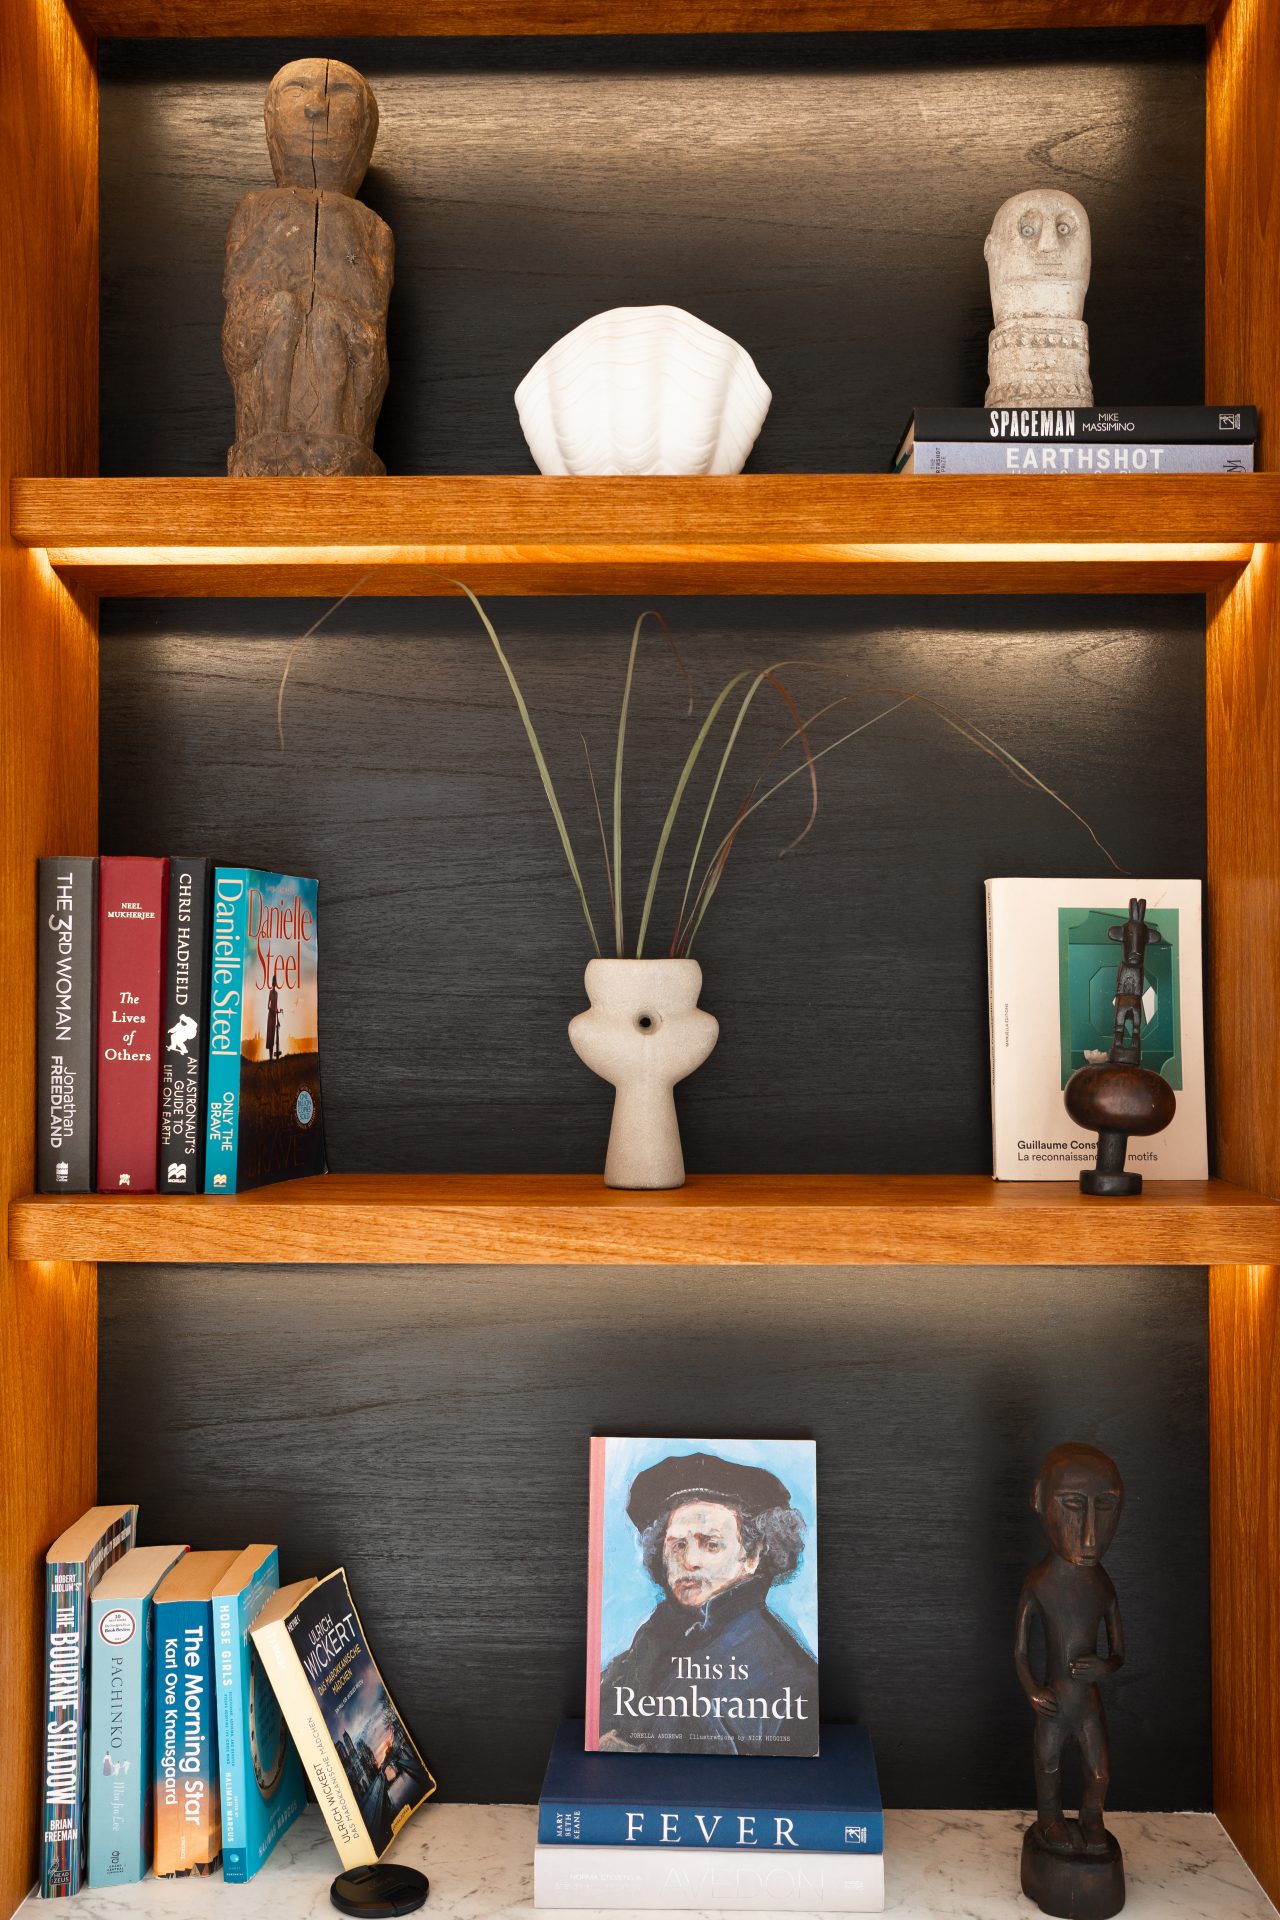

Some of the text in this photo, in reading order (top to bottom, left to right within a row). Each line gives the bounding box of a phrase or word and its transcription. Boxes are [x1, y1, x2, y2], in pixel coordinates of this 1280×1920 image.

[989, 410, 1075, 437] SPACEMAN
[1082, 422, 1135, 432] MASSIMINO
[1098, 413, 1119, 421] MIKE
[1006, 447, 1164, 470] EARTHSHOT
[107, 911, 155, 919] MUKHERJEE
[121, 902, 142, 910] NEEL
[248, 888, 313, 941] Danielle
[49, 872, 73, 1042] THE 3RD WOMAN
[175, 873, 192, 1006] CHRIS HADFIELD
[211, 878, 244, 1056] Danielle Steel
[255, 938, 301, 991] Steel
[119, 992, 140, 1006] The
[112, 1010, 146, 1024] Lives
[104, 1048, 151, 1062] Others
[122, 1031, 135, 1046] of
[50, 1056, 63, 1149] FREEDLAND
[63, 1066, 77, 1138] Jonathan
[161, 1064, 173, 1145] LIFE ON EARTH
[172, 1080, 185, 1135] GUIDE TO
[184, 1056, 198, 1154] AN ASTRONAUT'S
[210, 1102, 222, 1141] BRAVE
[221, 1092, 235, 1152] ONLY THE
[1017, 1140, 1100, 1150] Guillaume Const
[1017, 1152, 1158, 1161] La reconnaissanc motifs
[51, 1582, 82, 1593] LUDLUM'S
[54, 1574, 77, 1584] ROBERT
[219, 1605, 230, 1648] HORSE
[308, 1613, 334, 1646] ULRICH
[303, 1612, 356, 1681] WICKERT
[221, 1651, 233, 1687] GIRLS
[317, 1680, 328, 1696] DAS
[324, 1643, 362, 1684] MAROKKANISCHE
[671, 1655, 749, 1680] This is
[46, 1605, 80, 1805] THE BOURNE SHADOW
[110, 1657, 124, 1749] PACHINKO
[613, 1685, 809, 1720] Rembrandt
[161, 1638, 178, 1806] Karl Ove Knausgaard
[179, 1625, 206, 1827] The Morning Star
[689, 1733, 734, 1741] Illustrations
[737, 1734, 745, 1742] by
[313, 1763, 351, 1844] ULRICH WICKERT
[323, 1755, 352, 1821] MAROKKANISCHE
[50, 1818, 73, 1830] BRIAN
[224, 1772, 235, 1843] HALIMAH MARCUS
[556, 1812, 564, 1837] MARY
[564, 1813, 572, 1837] BETH
[573, 1810, 581, 1839] KEANE
[44, 1829, 78, 1842] FREEMAN
[347, 1818, 360, 1839] DAS
[624, 1812, 800, 1847] FEVER
